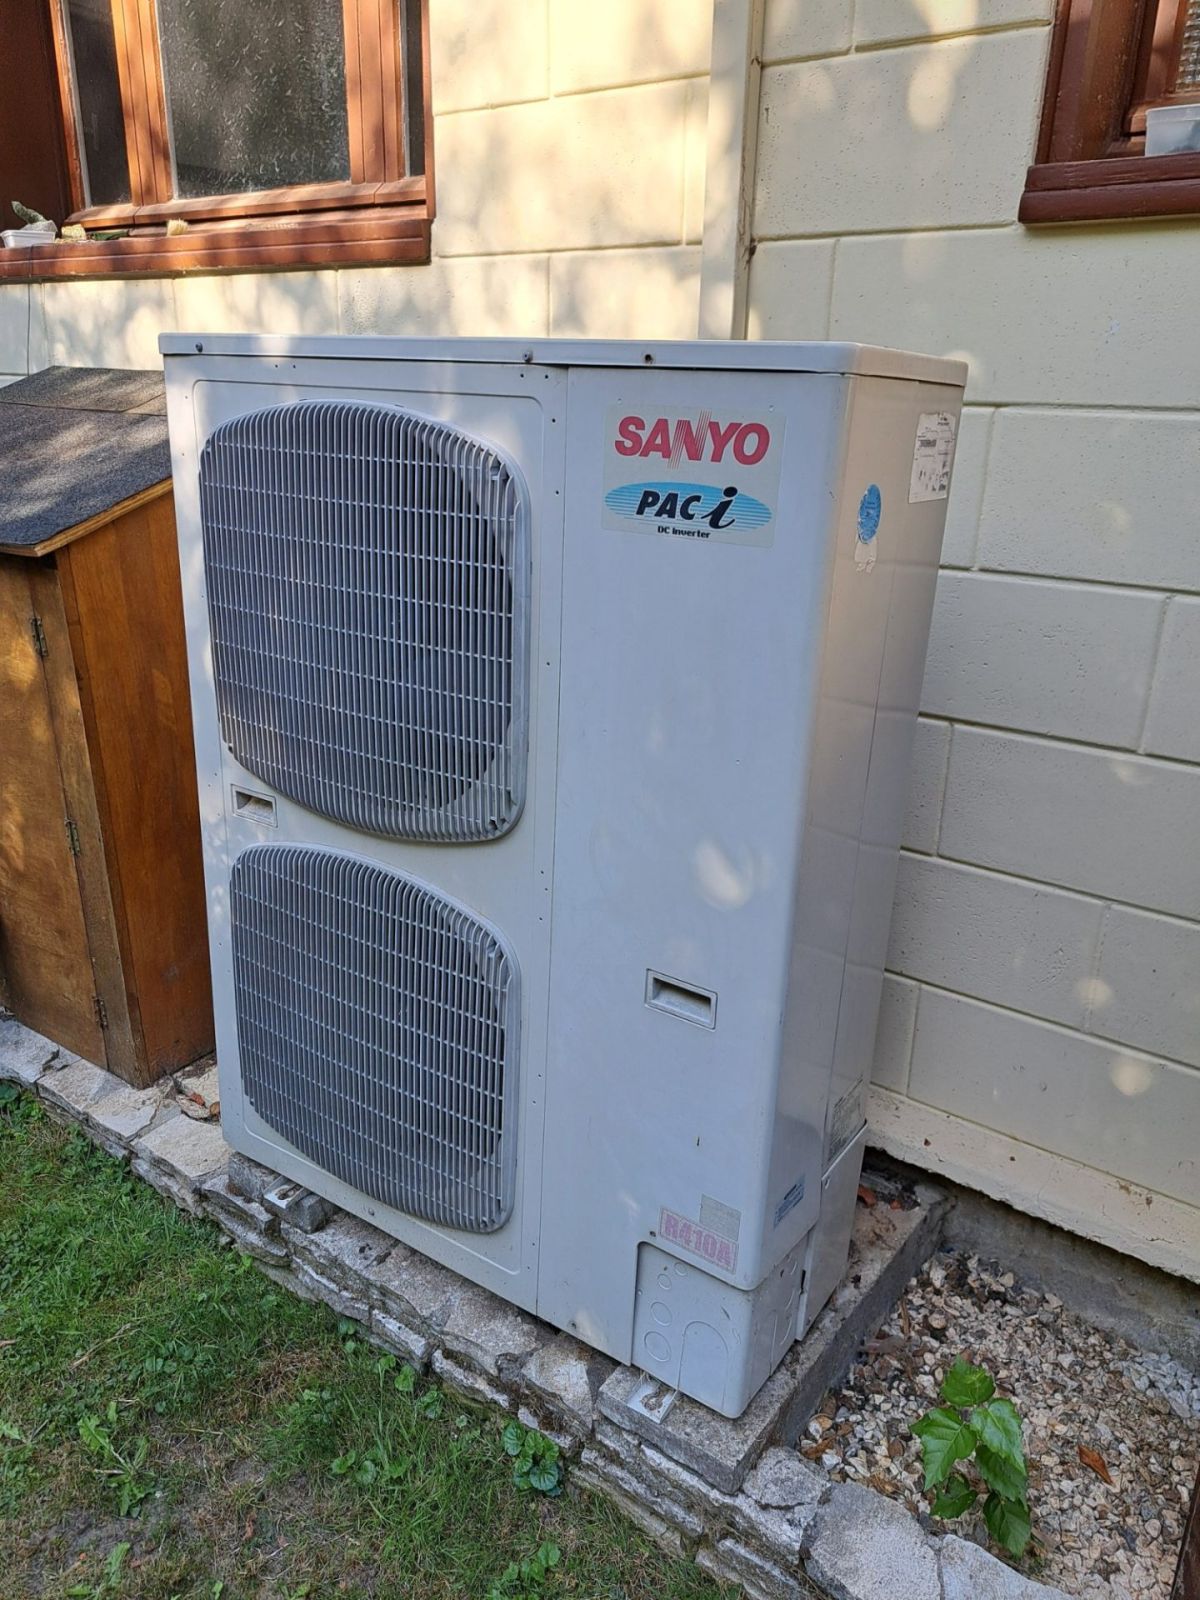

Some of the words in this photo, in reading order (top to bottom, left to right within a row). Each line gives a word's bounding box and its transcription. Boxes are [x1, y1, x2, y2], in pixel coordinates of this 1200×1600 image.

[615, 413, 770, 467] SANYO
[657, 525, 670, 534] DC
[664, 1213, 733, 1266] R410A
